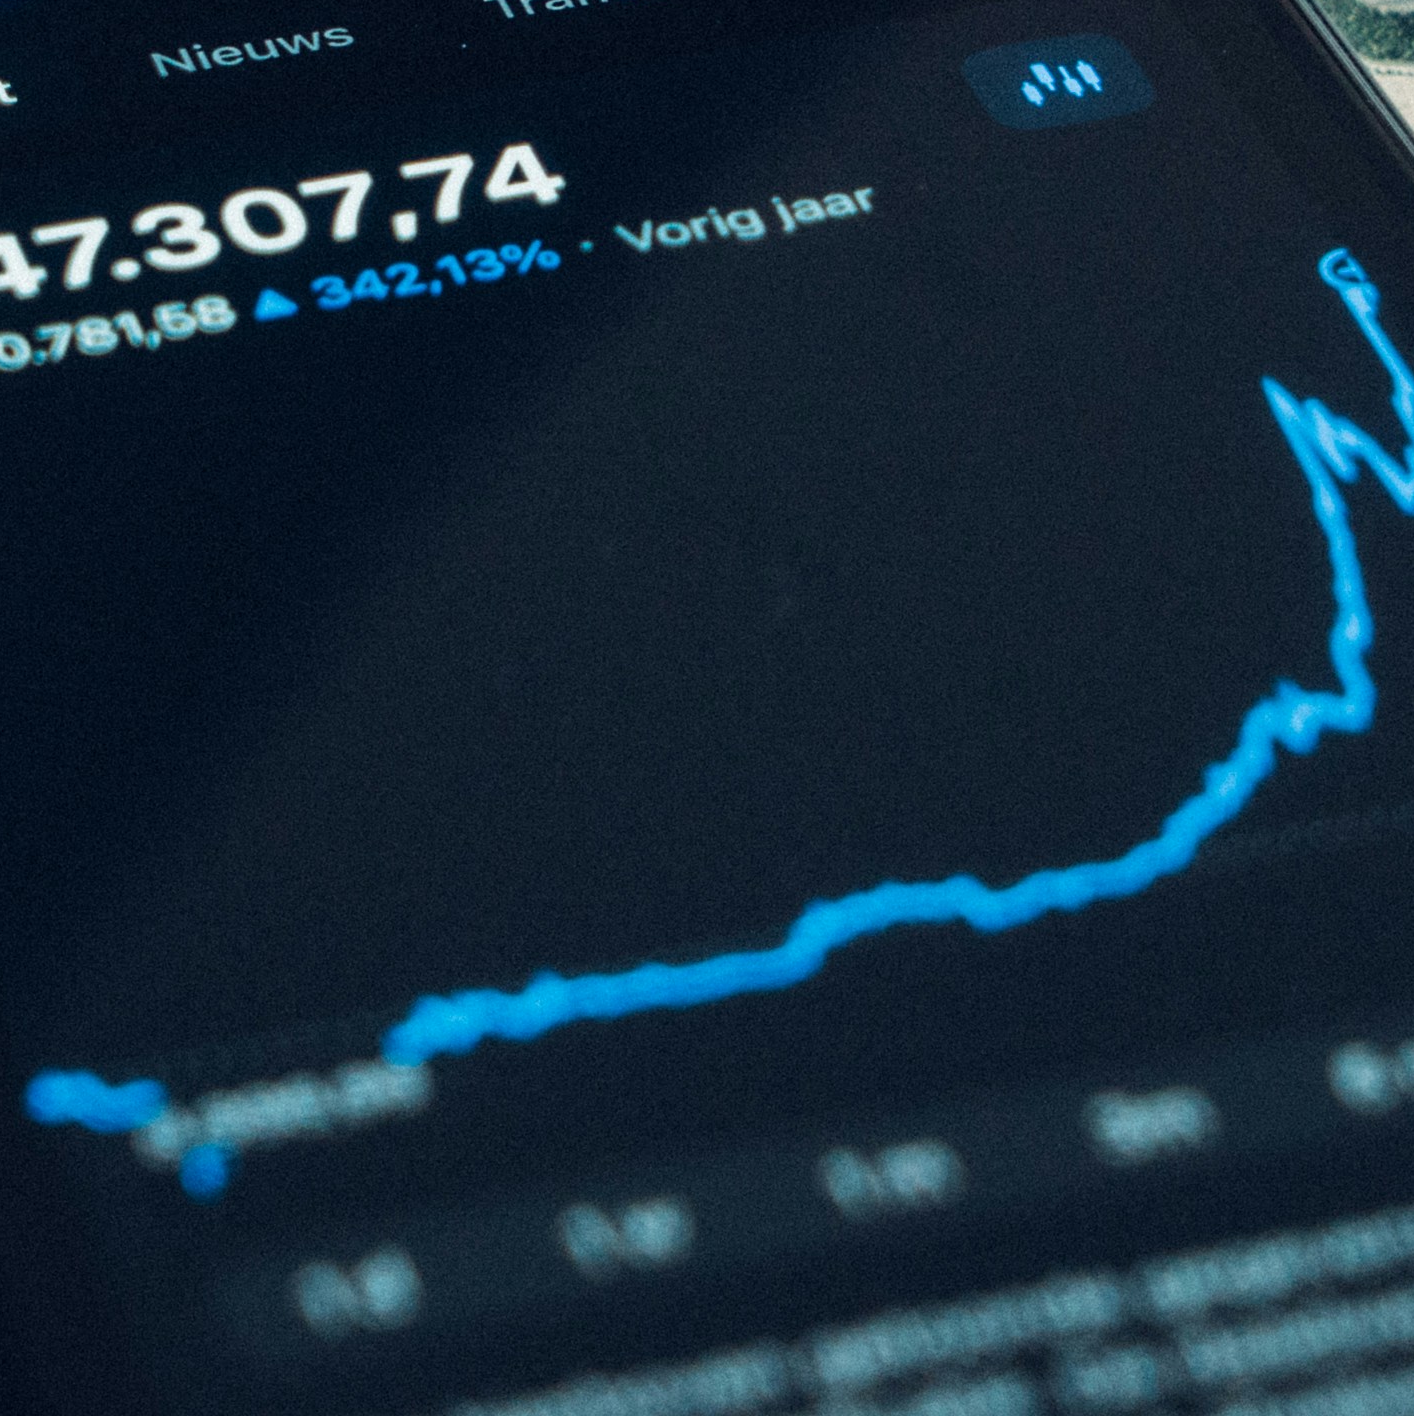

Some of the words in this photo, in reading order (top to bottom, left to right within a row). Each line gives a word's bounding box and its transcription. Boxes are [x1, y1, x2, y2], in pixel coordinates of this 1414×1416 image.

[149, 25, 355, 79] Nieuws
[310, 238, 562, 311] 342,13%
[613, 206, 768, 255] Vorig
[770, 186, 876, 235] jaar
